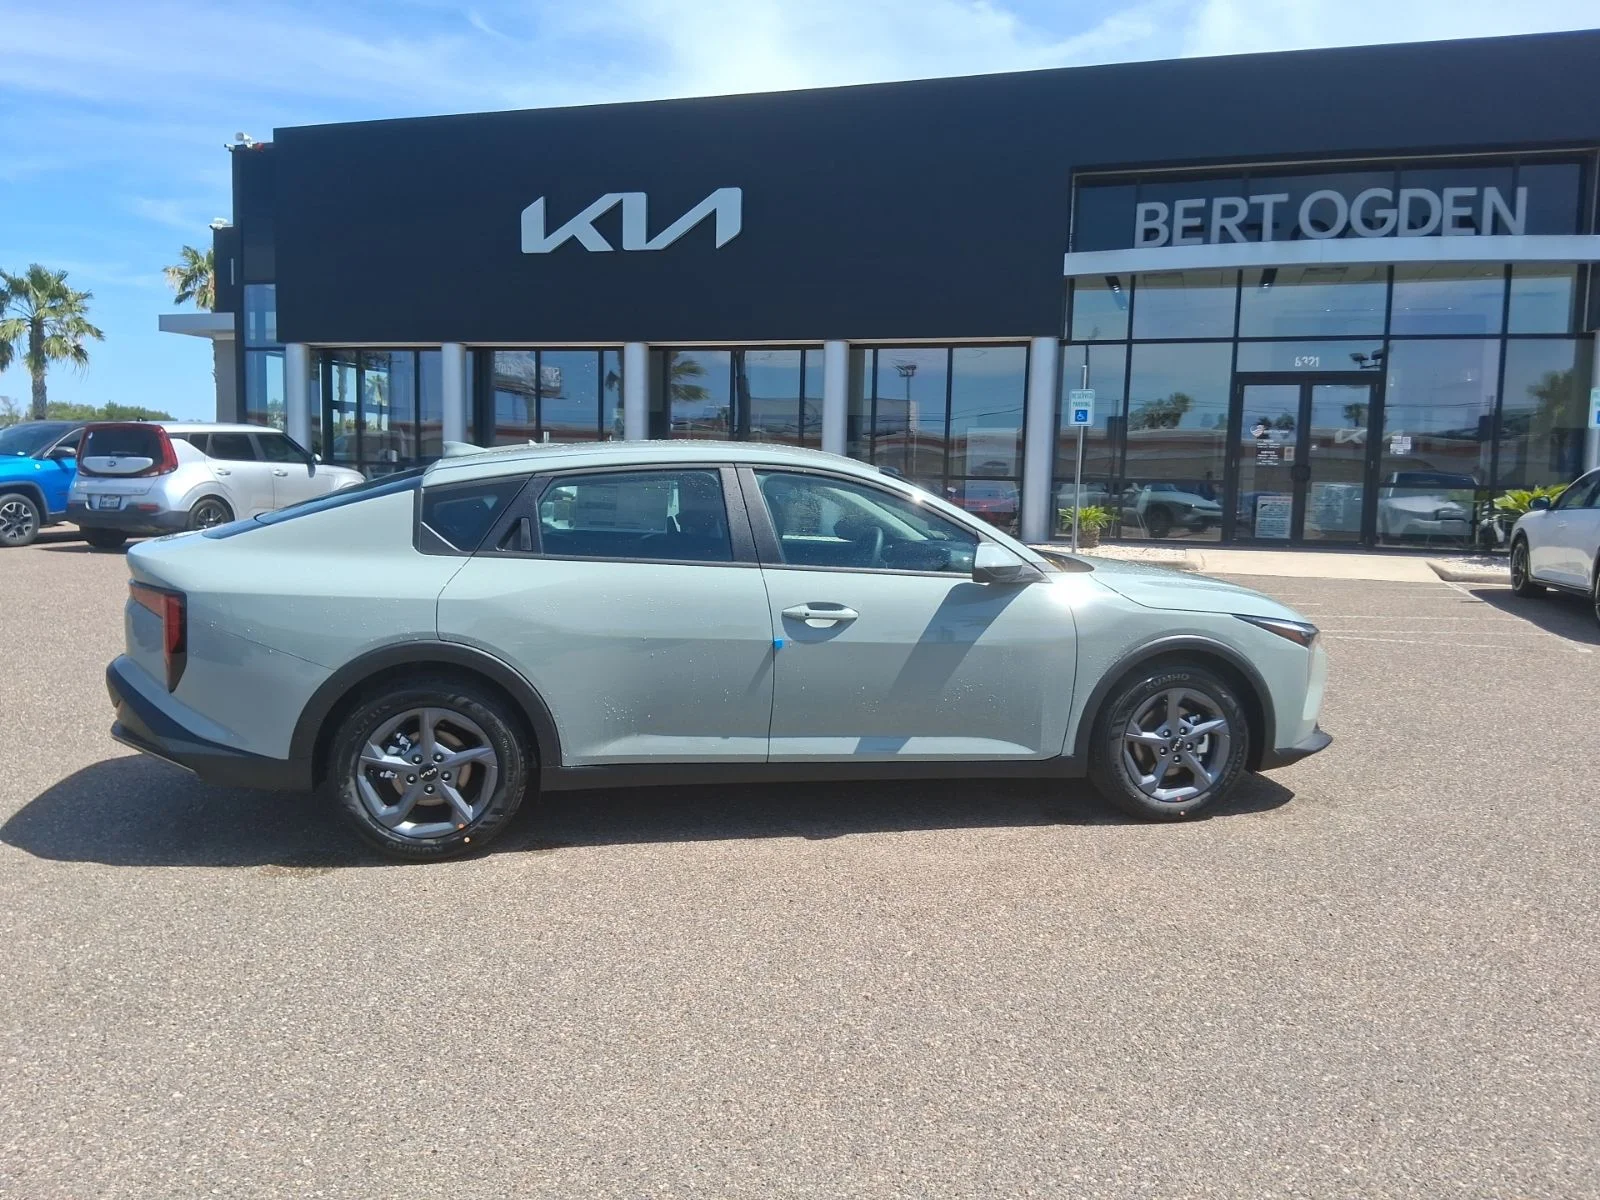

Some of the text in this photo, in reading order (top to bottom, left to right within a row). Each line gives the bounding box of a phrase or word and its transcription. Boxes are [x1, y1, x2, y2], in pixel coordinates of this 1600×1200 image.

[521, 187, 742, 254] KIA
[1134, 186, 1528, 249] BERT OGDEN
